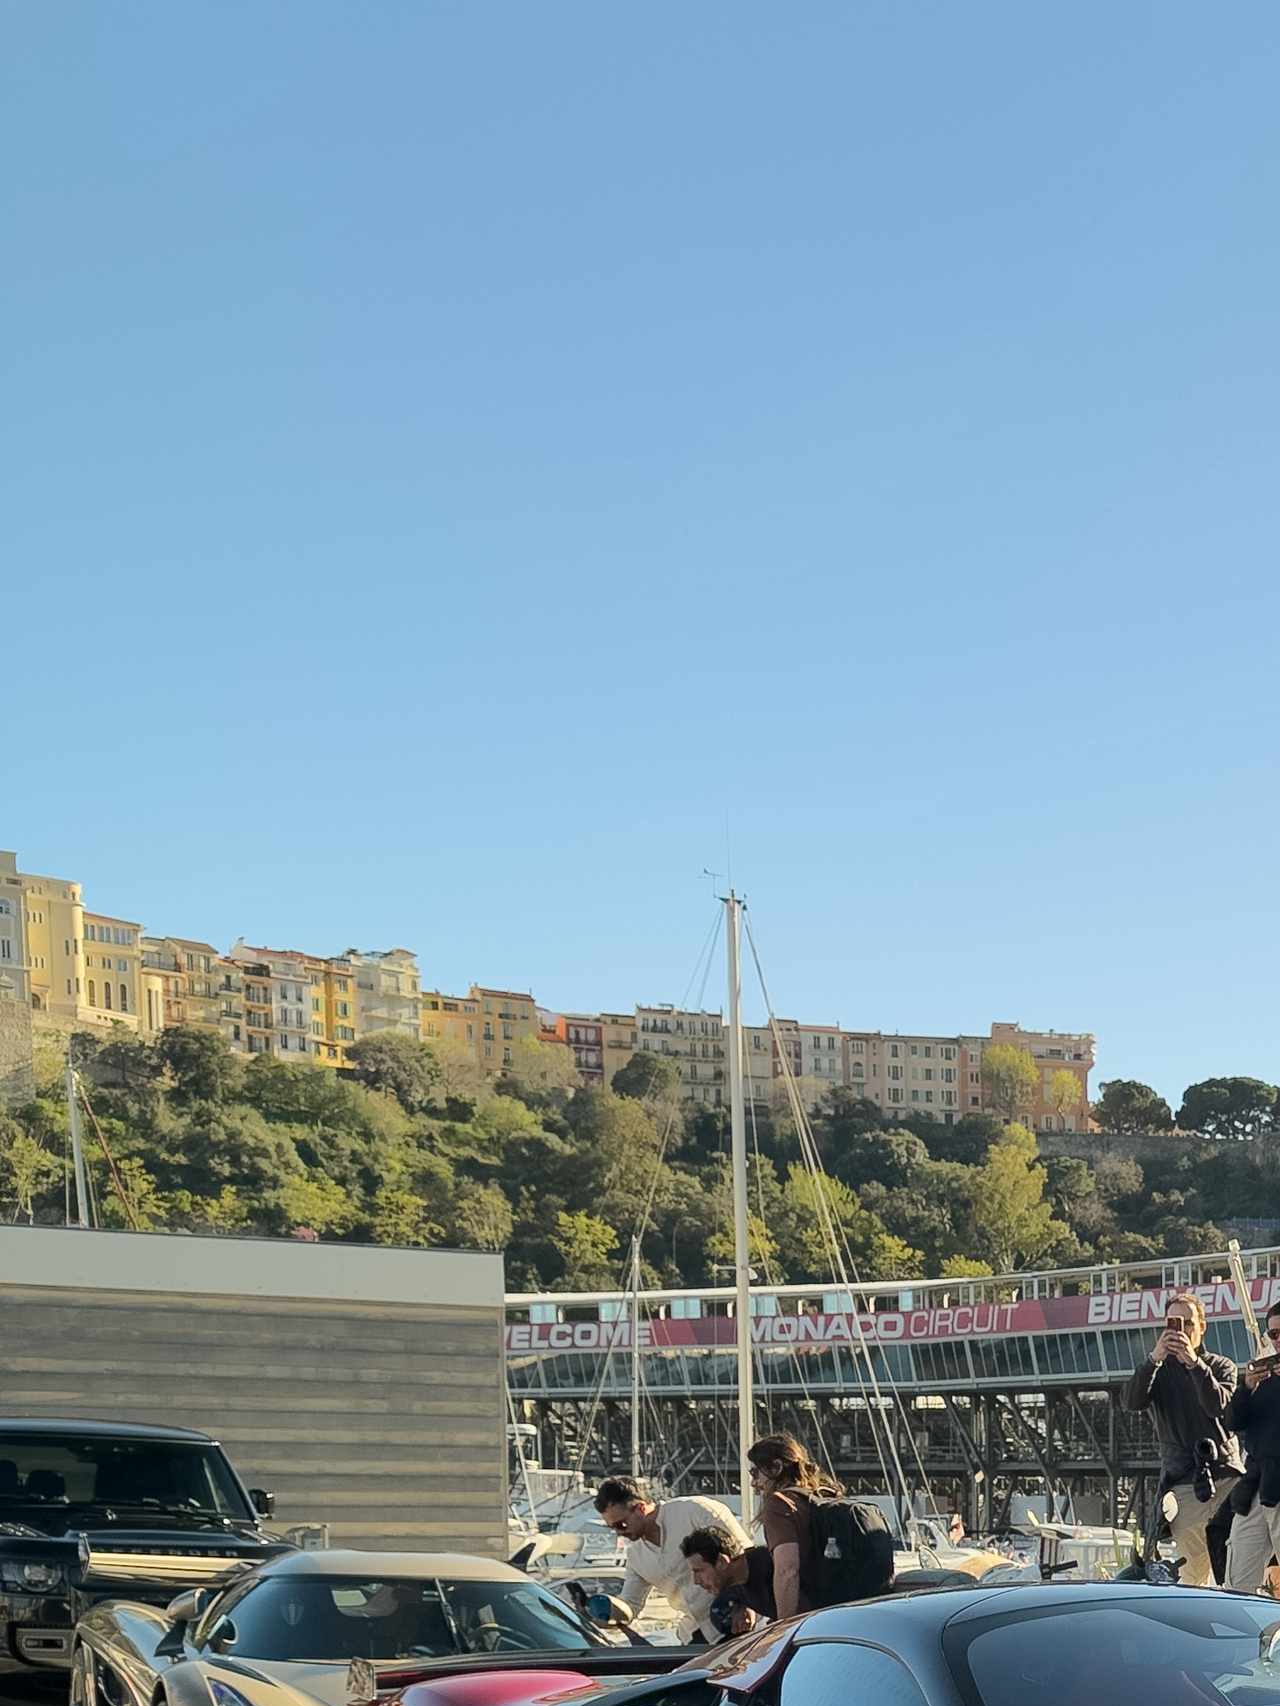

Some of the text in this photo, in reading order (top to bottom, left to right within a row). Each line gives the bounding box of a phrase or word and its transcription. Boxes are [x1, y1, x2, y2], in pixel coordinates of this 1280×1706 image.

[504, 1321, 650, 1349] ELCOME
[750, 1303, 1019, 1341] MONACO CIRCUIT
